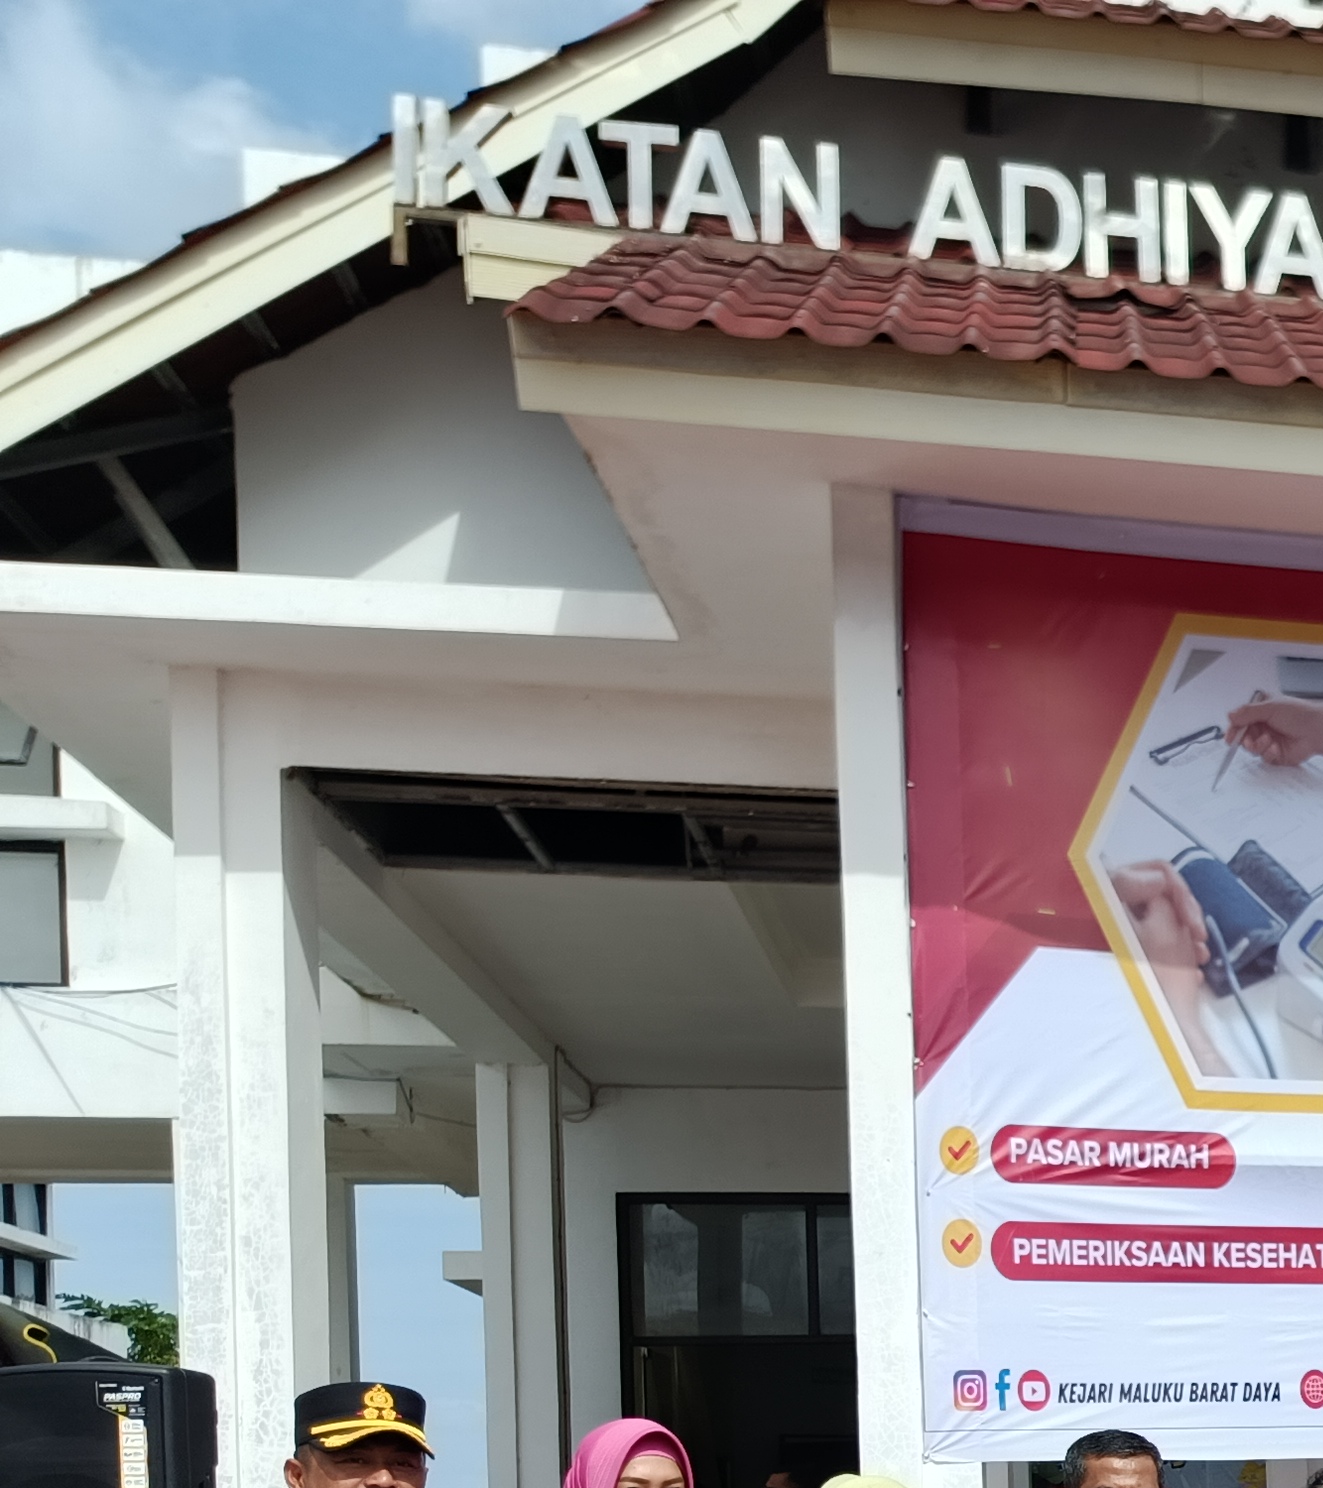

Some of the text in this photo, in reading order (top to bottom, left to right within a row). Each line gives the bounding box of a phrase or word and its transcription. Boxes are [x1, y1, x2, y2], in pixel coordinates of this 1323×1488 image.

[391, 93, 843, 251] IKATAN
[1009, 1137, 1210, 1171] PASAR MURAH
[1012, 1237, 1205, 1269] PEMERIKSAAN
[1058, 1381, 1281, 1404] KEJARI MALUKU BARAT DAYA
